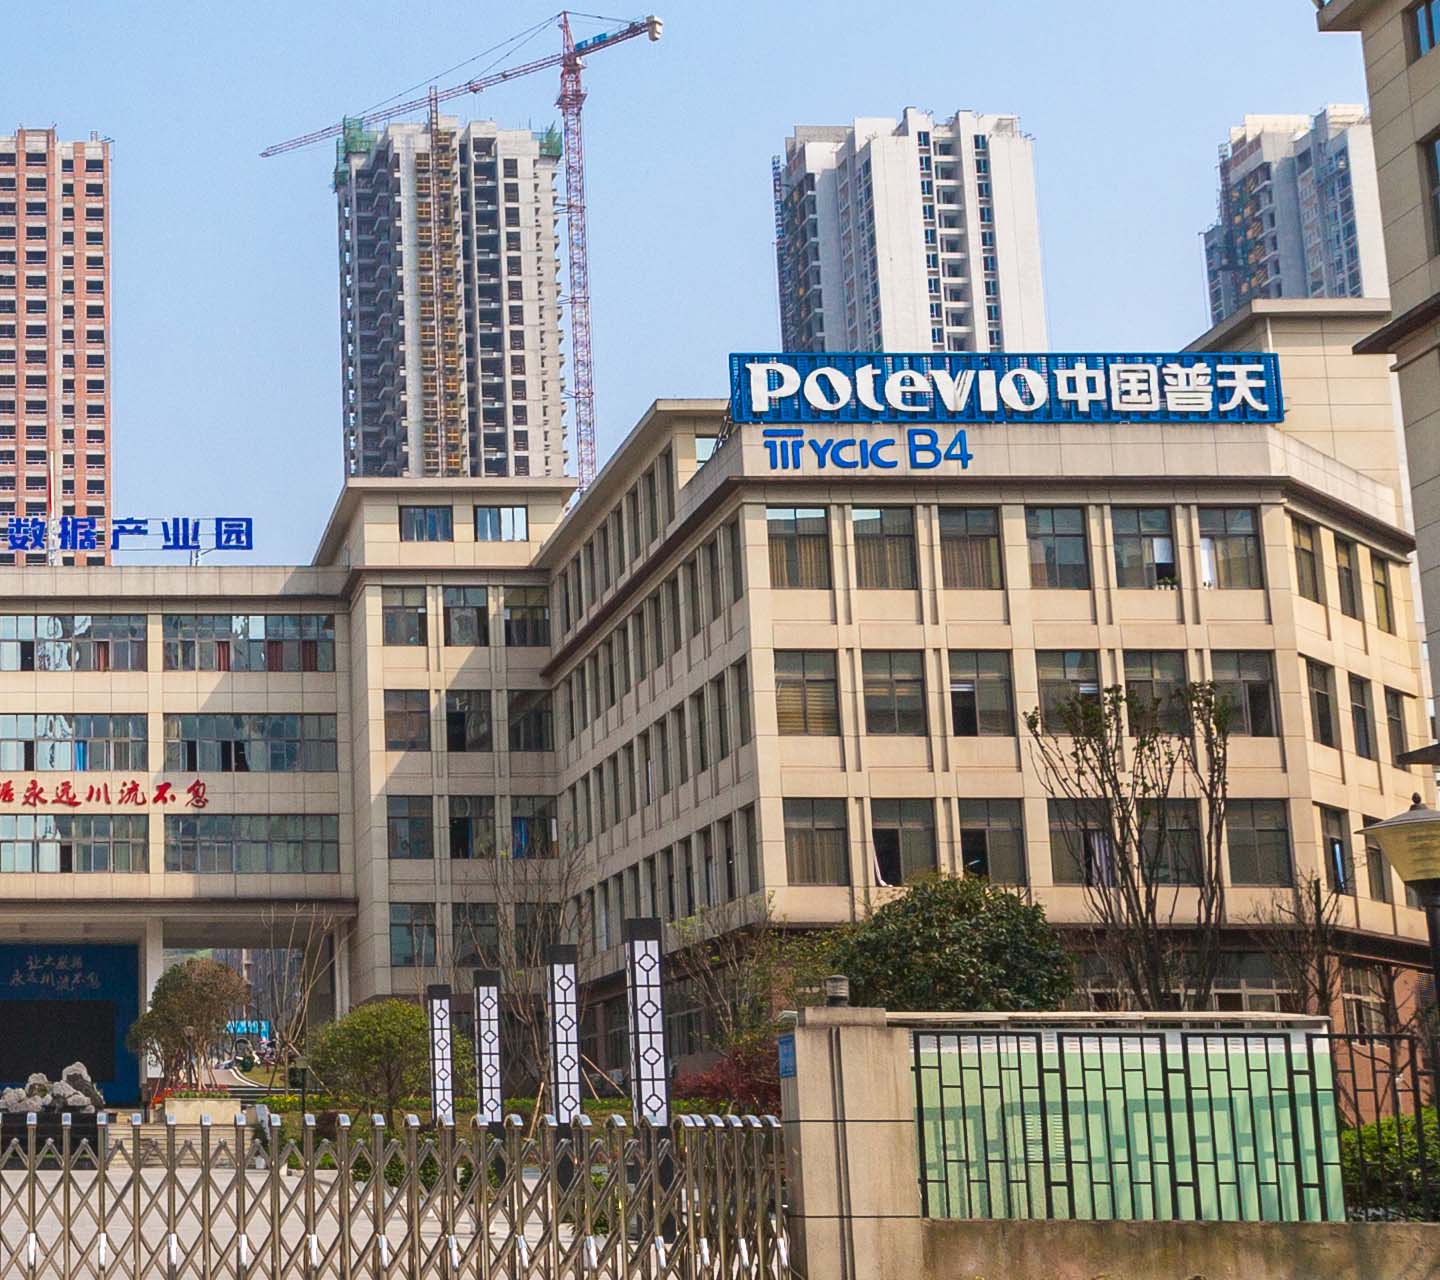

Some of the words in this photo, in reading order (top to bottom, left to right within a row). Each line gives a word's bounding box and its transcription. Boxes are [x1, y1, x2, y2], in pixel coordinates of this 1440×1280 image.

[1052, 362, 1270, 413] 中国普天
[907, 427, 975, 470] B4
